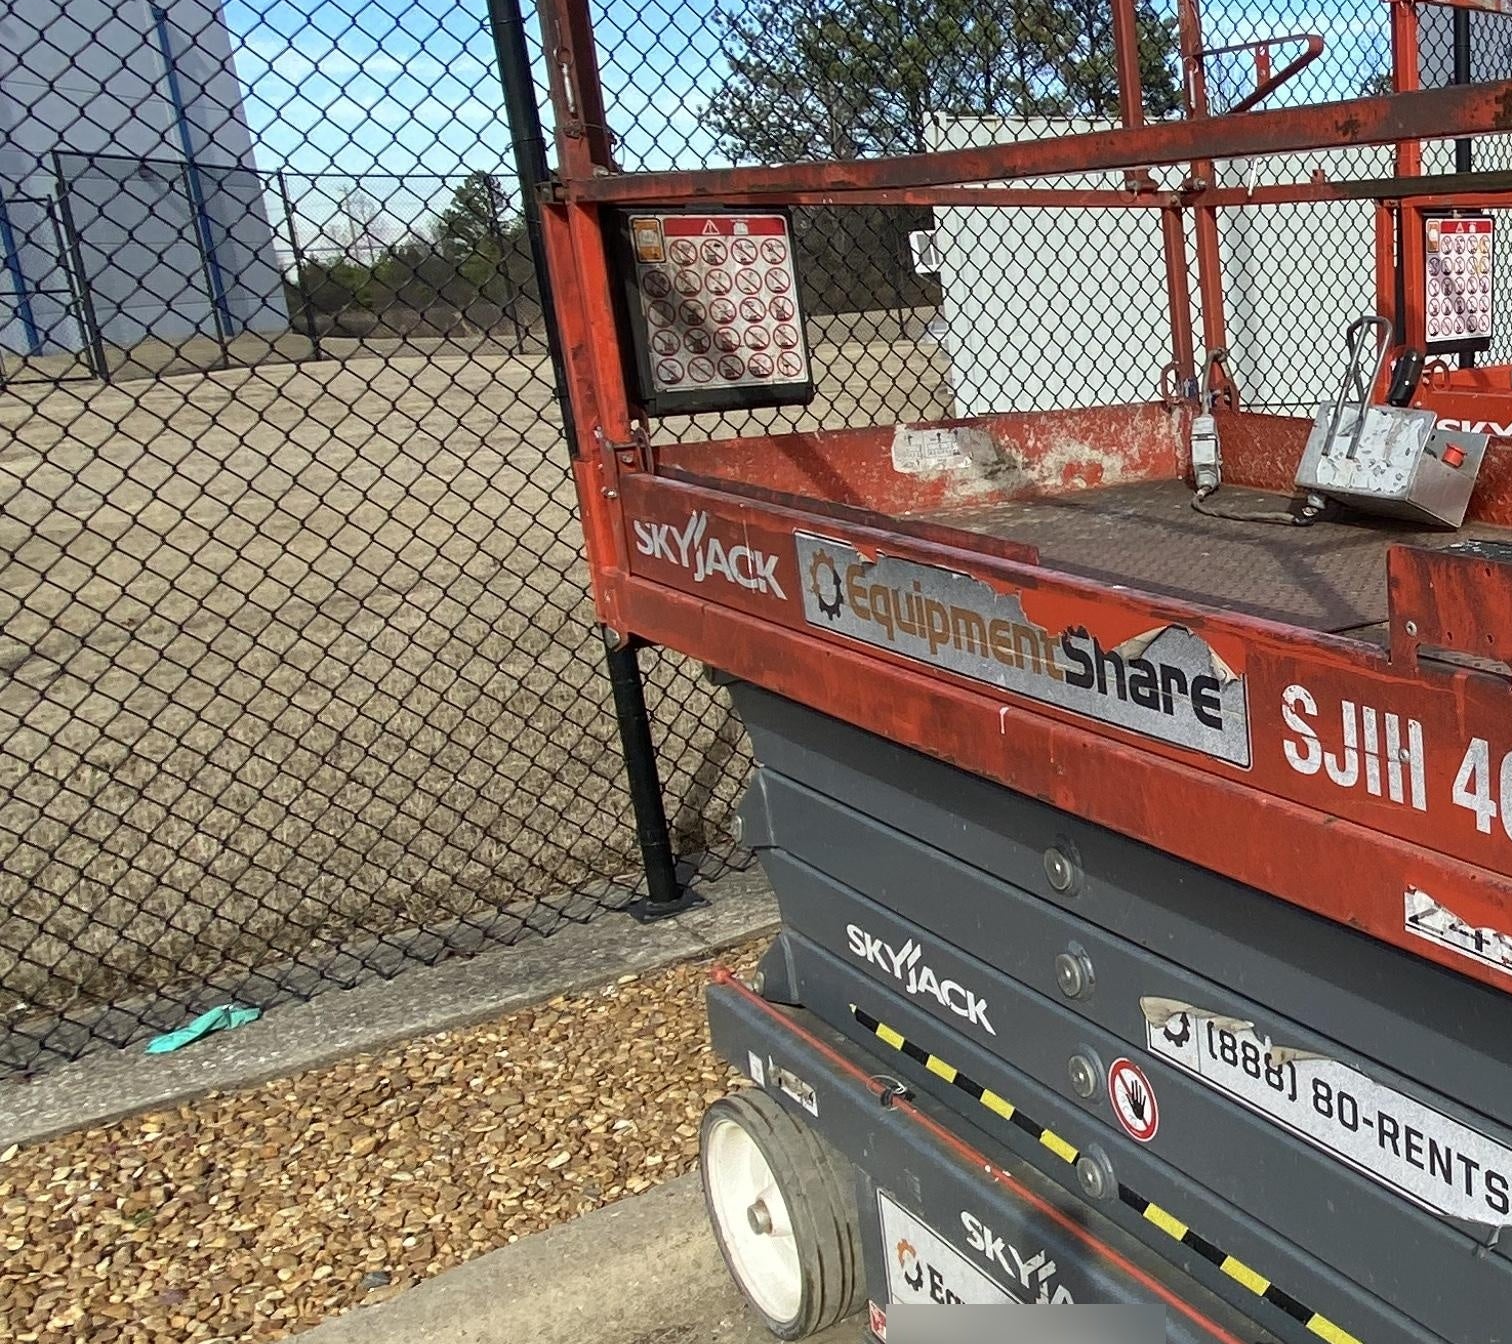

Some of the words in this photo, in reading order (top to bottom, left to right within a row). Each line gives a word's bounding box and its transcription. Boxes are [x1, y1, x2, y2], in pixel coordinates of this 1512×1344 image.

[634, 511, 787, 601] SKYJACK
[846, 573, 1224, 731] EquipmentShare
[846, 923, 997, 1036] SKYJACK
[1206, 1020, 1297, 1102] (888)
[1312, 1077, 1509, 1215] 80-RENTS
